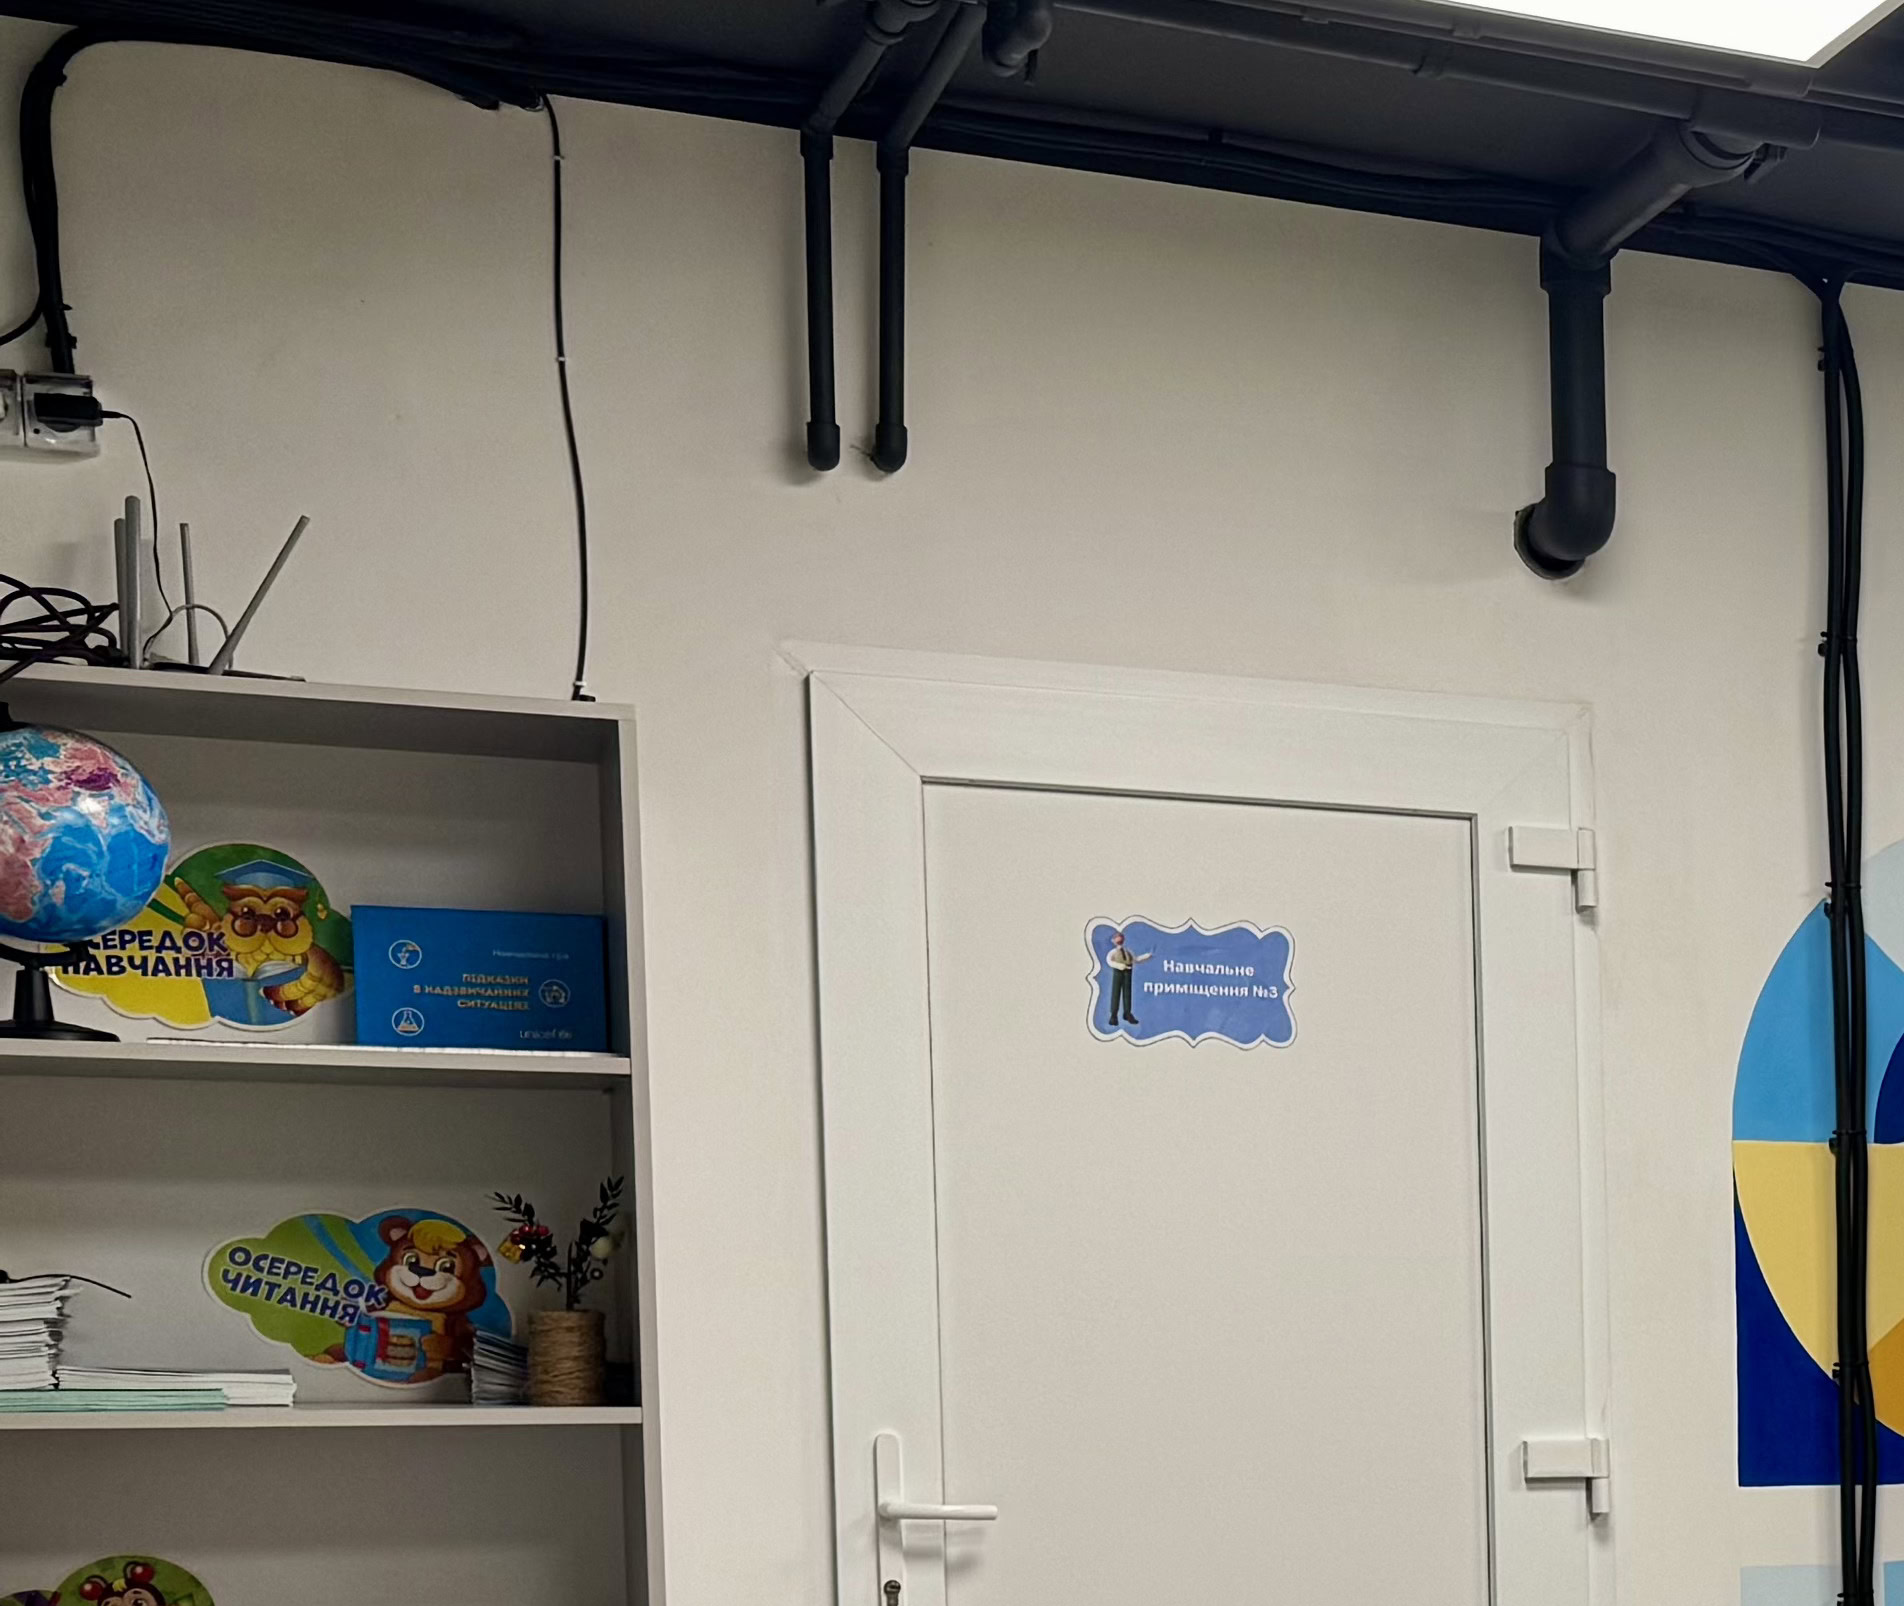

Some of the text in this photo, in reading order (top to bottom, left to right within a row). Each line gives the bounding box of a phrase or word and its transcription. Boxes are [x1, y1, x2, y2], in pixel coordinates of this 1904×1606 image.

[88, 929, 229, 956] ЕРЕДОК
[1163, 960, 1255, 977] Навчальне
[1144, 981, 1279, 999] приміщення №3
[228, 1246, 388, 1307] ОСЕРЕДОК
[222, 1268, 360, 1324] ЧИТАННЯ
